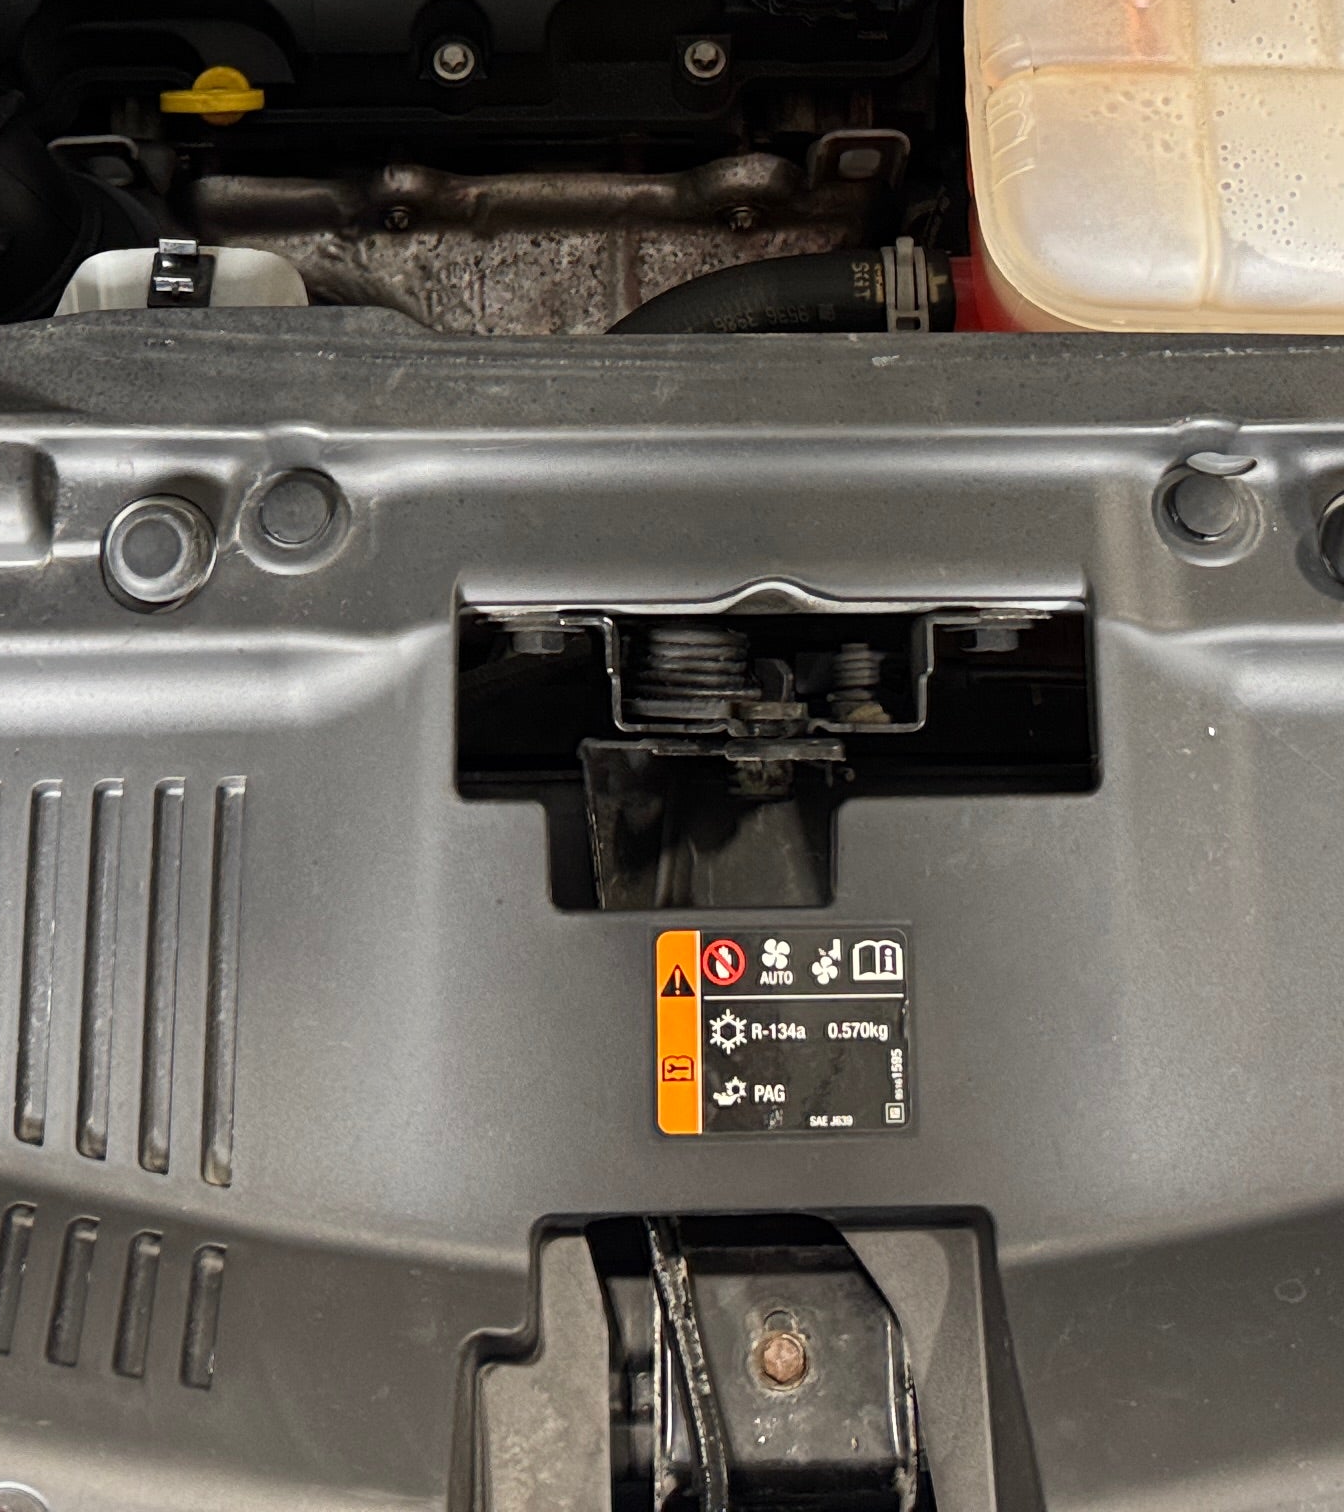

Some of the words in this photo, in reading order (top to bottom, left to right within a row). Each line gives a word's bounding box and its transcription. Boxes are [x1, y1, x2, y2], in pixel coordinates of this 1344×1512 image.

[759, 970, 794, 985] AUTO
[751, 1021, 807, 1041] R-134a
[827, 1021, 889, 1042] 0.570kg
[754, 1084, 786, 1103] PAG
[809, 1115, 828, 1127] SAE
